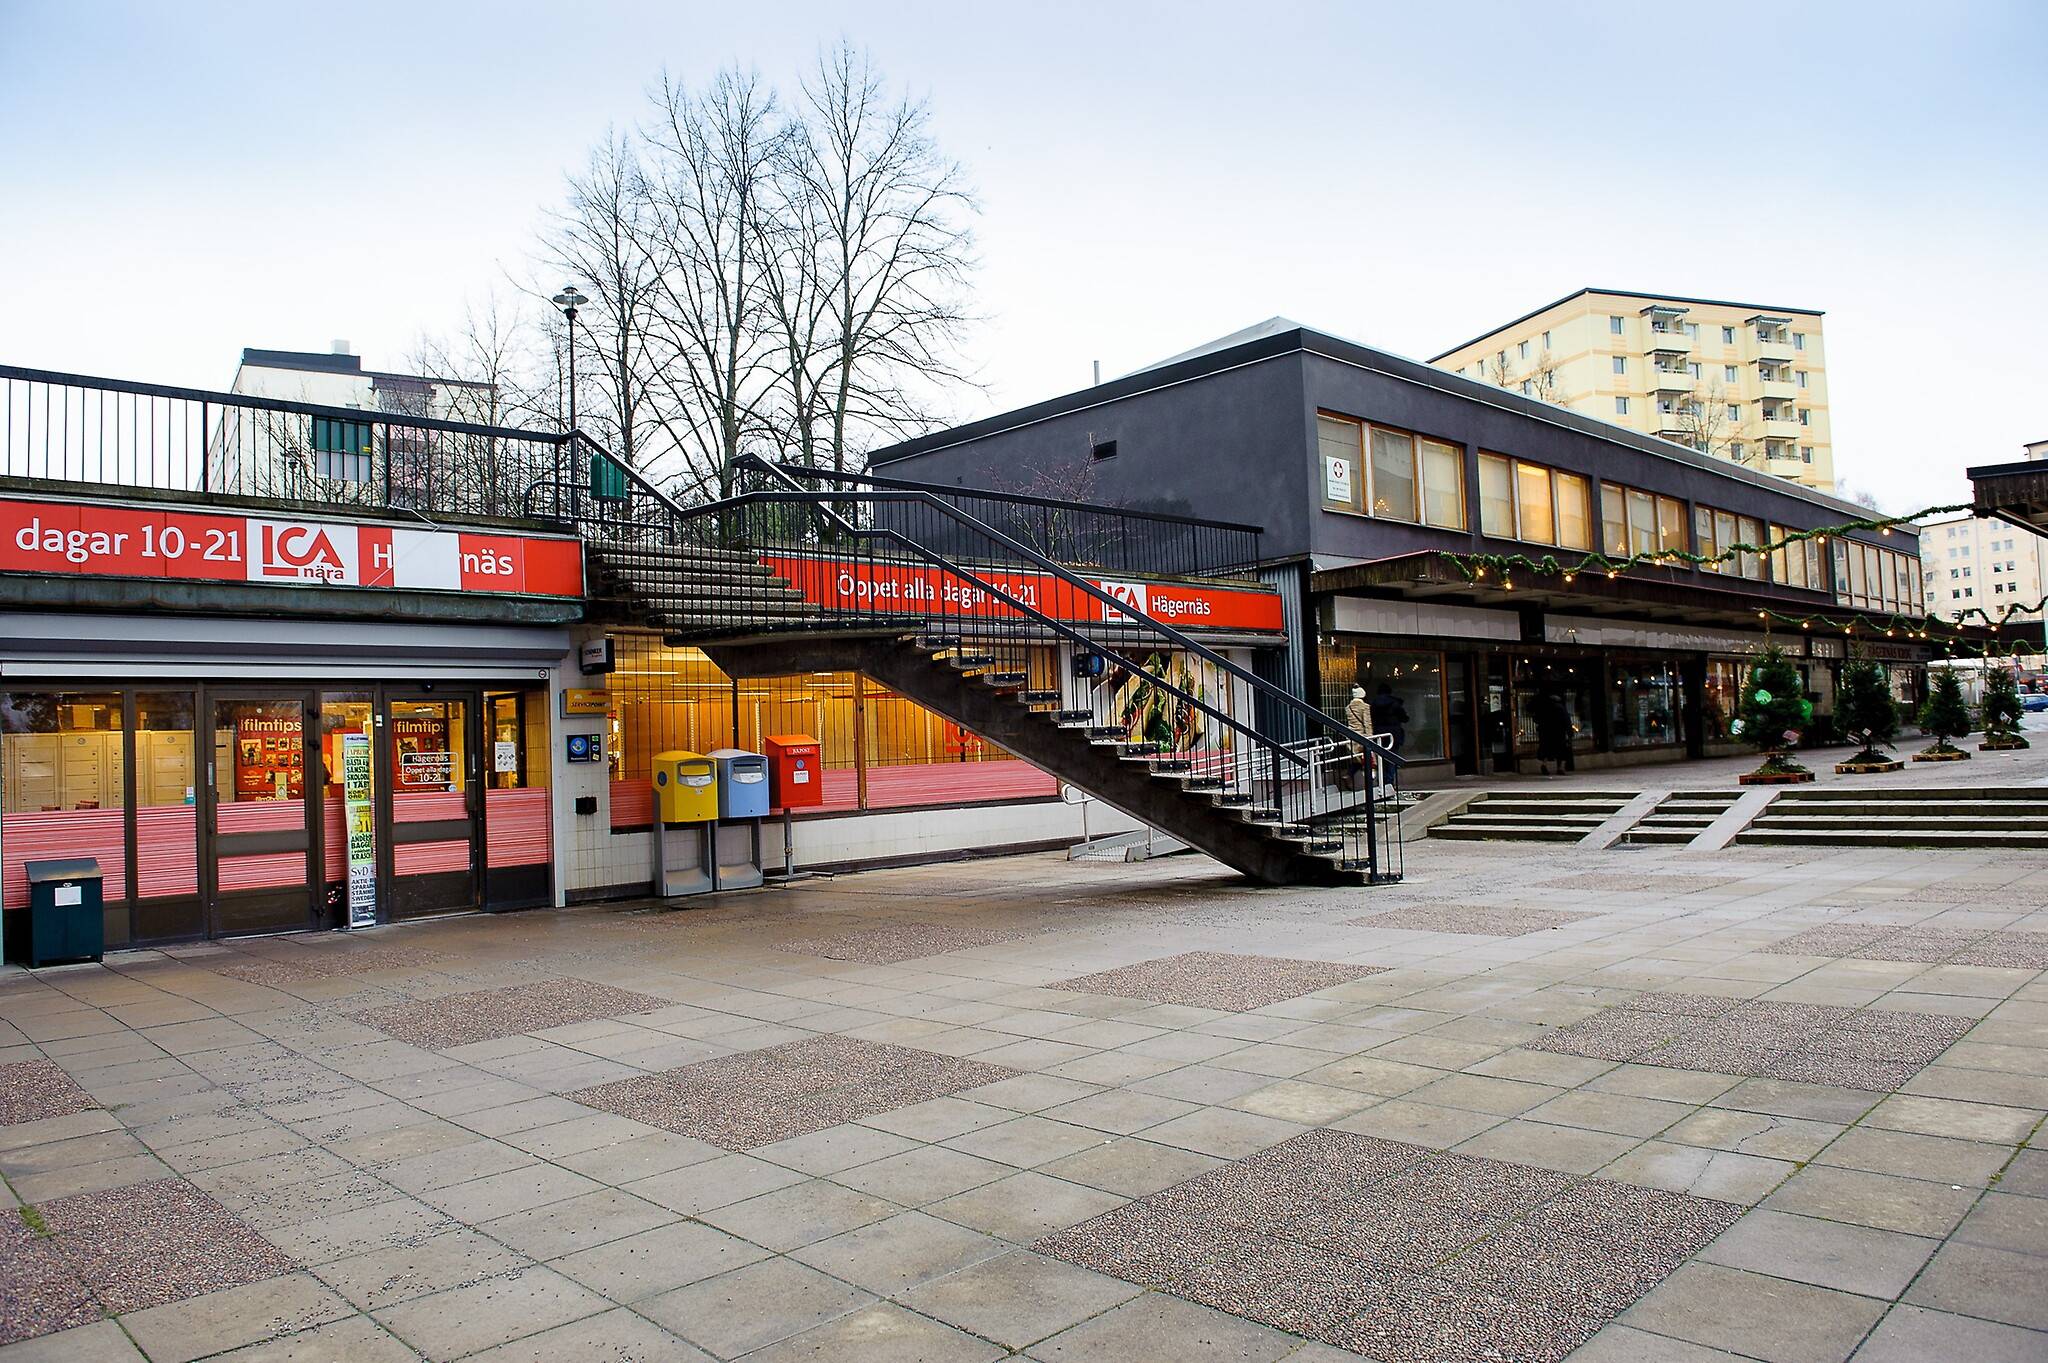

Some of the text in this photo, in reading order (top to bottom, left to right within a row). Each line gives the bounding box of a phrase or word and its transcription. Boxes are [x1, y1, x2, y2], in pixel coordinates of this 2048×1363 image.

[15, 517, 241, 563] dagar 10-21
[262, 525, 344, 569] ICA
[303, 566, 344, 580] nära
[838, 569, 900, 602] Öppet
[905, 577, 934, 600] alla
[1152, 595, 1211, 618] Hägernäs
[243, 718, 302, 734] filmtips
[412, 754, 449, 763] Hägernäs
[351, 866, 369, 877] SvD
